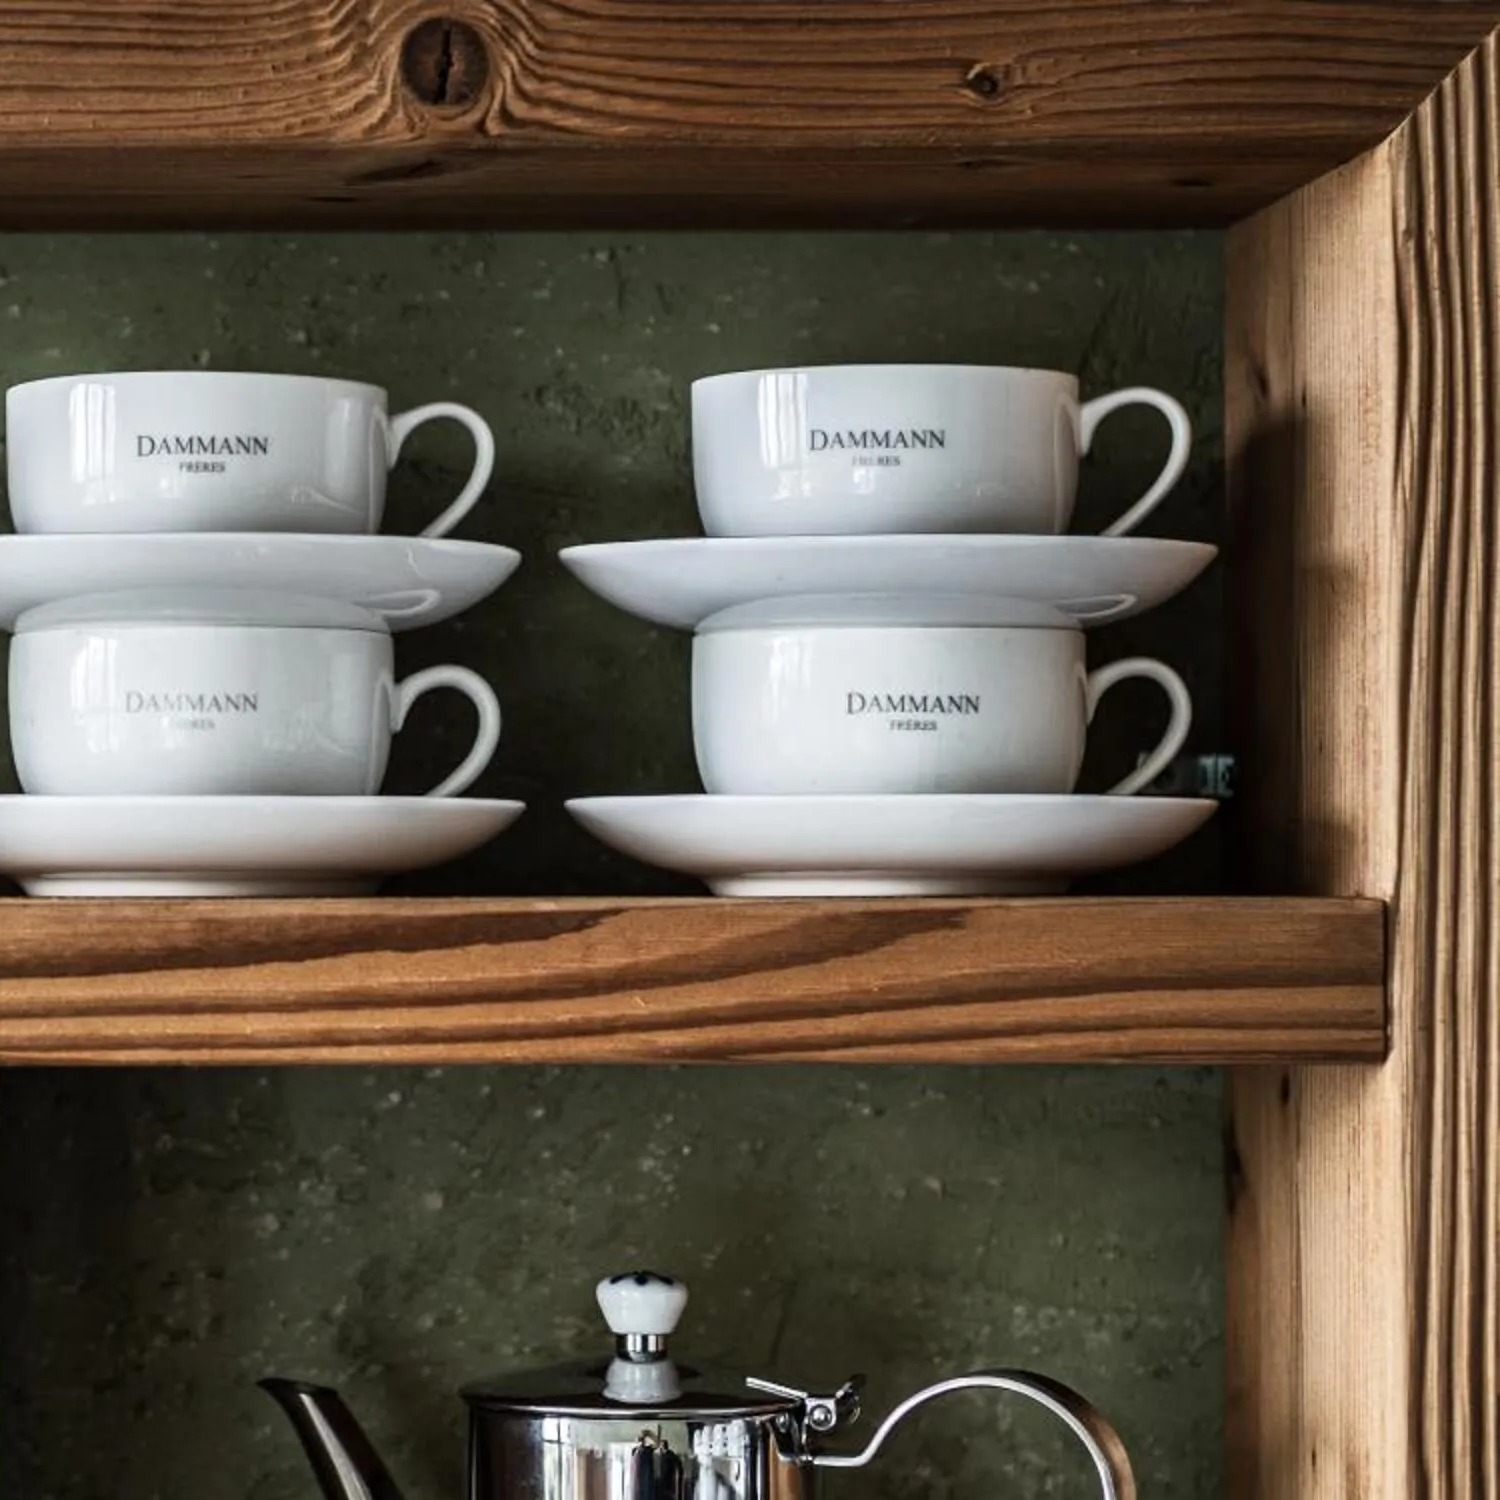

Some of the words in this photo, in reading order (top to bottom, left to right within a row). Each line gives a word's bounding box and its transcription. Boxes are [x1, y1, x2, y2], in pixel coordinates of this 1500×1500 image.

[137, 435, 269, 456] DAMMANN
[810, 429, 945, 451] DAMMANN
[126, 692, 258, 714] DAMMANN
[847, 692, 980, 714] DAMMANN
